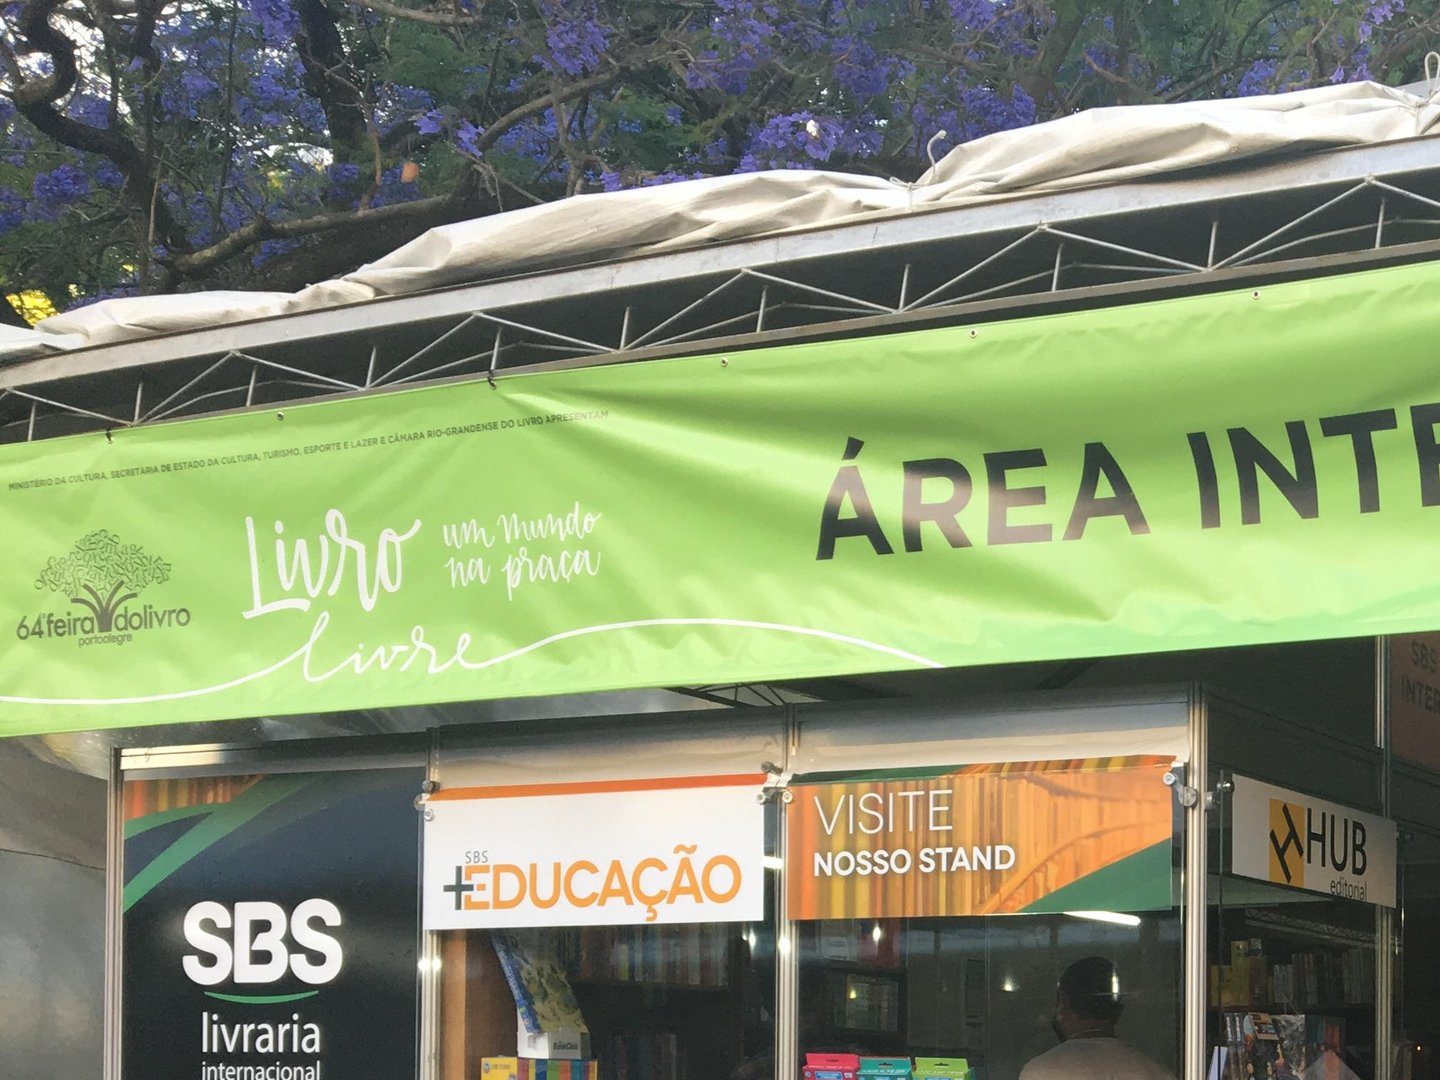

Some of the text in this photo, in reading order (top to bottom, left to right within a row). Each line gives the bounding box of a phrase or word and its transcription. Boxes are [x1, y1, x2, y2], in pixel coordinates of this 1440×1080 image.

[55, 475, 68, 487] DA
[110, 465, 160, 480] SECRETARIA
[161, 463, 173, 474] DE
[173, 459, 206, 472] ESTADO
[208, 456, 220, 468] DA
[304, 442, 342, 455] ESPORTE
[350, 436, 379, 449] LAZER
[388, 430, 425, 444] CÂMARA
[426, 420, 499, 440] RIO-GRANDENSE
[501, 418, 515, 429] DO
[516, 415, 544, 428] LIVRO
[545, 409, 609, 425] APRESENTAM
[816, 437, 1151, 561] ÁREA
[443, 501, 603, 550] um mundo
[243, 508, 422, 619] Livro
[444, 548, 601, 600] na praça
[303, 610, 476, 683] livre
[1411, 639, 1438, 674] SBS
[813, 789, 953, 835] VISITE
[465, 850, 489, 864] SBS
[813, 844, 1016, 878] NOSSO STAND
[1330, 877, 1368, 902] editorial
[182, 897, 343, 985] SBS
[201, 1010, 321, 1054] livraria
